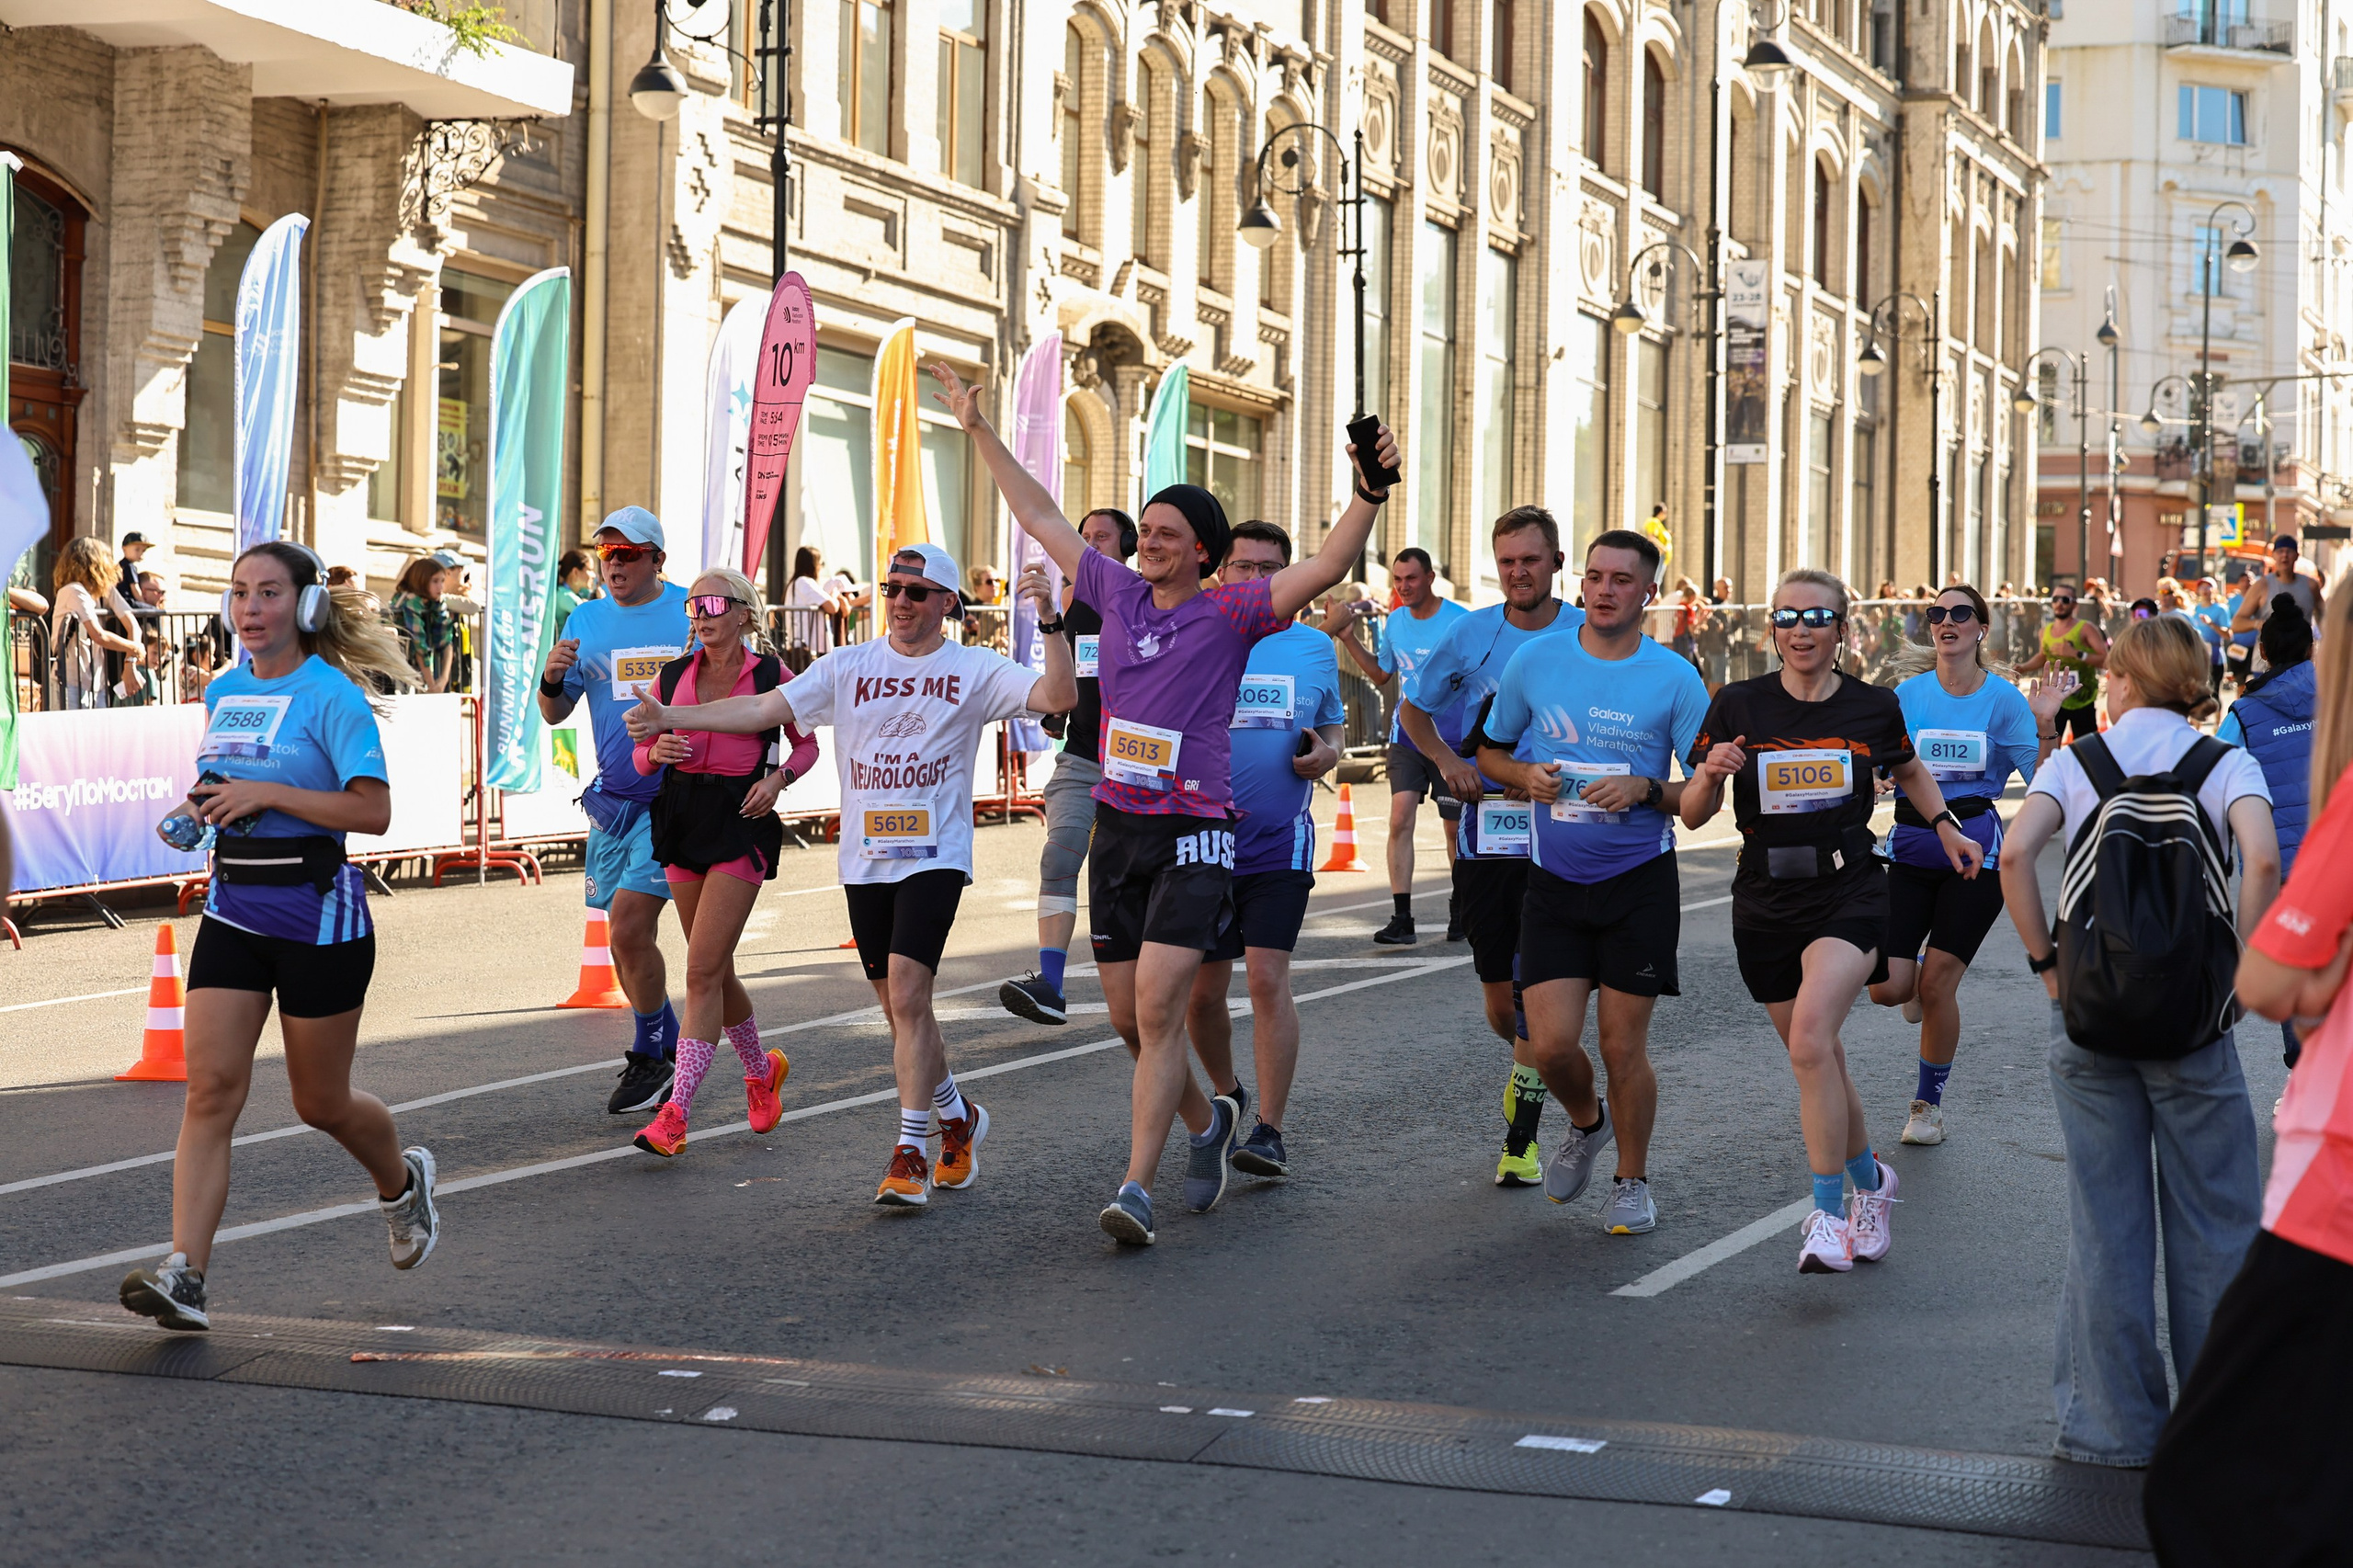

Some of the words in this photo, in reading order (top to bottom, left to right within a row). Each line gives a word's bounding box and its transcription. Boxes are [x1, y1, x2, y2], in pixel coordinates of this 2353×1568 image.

[772, 342, 792, 386] 10
[794, 337, 805, 354] km
[501, 609, 516, 660] CLUB
[854, 676, 916, 708] KISS
[921, 675, 961, 706] ME
[217, 711, 267, 728] 7588
[1588, 706, 1634, 726] Galaxy
[1587, 722, 1654, 741] Vladivostok
[1116, 736, 1160, 761] 5613
[1586, 735, 1643, 752] Marathon
[1931, 743, 1968, 759] 8112
[874, 752, 901, 765] I'M
[905, 752, 919, 763] A
[850, 754, 950, 790] NEUROLOGIST
[1778, 766, 1833, 785] 5106
[13, 776, 173, 816] #БегуПоМостам
[873, 815, 917, 832] 5612
